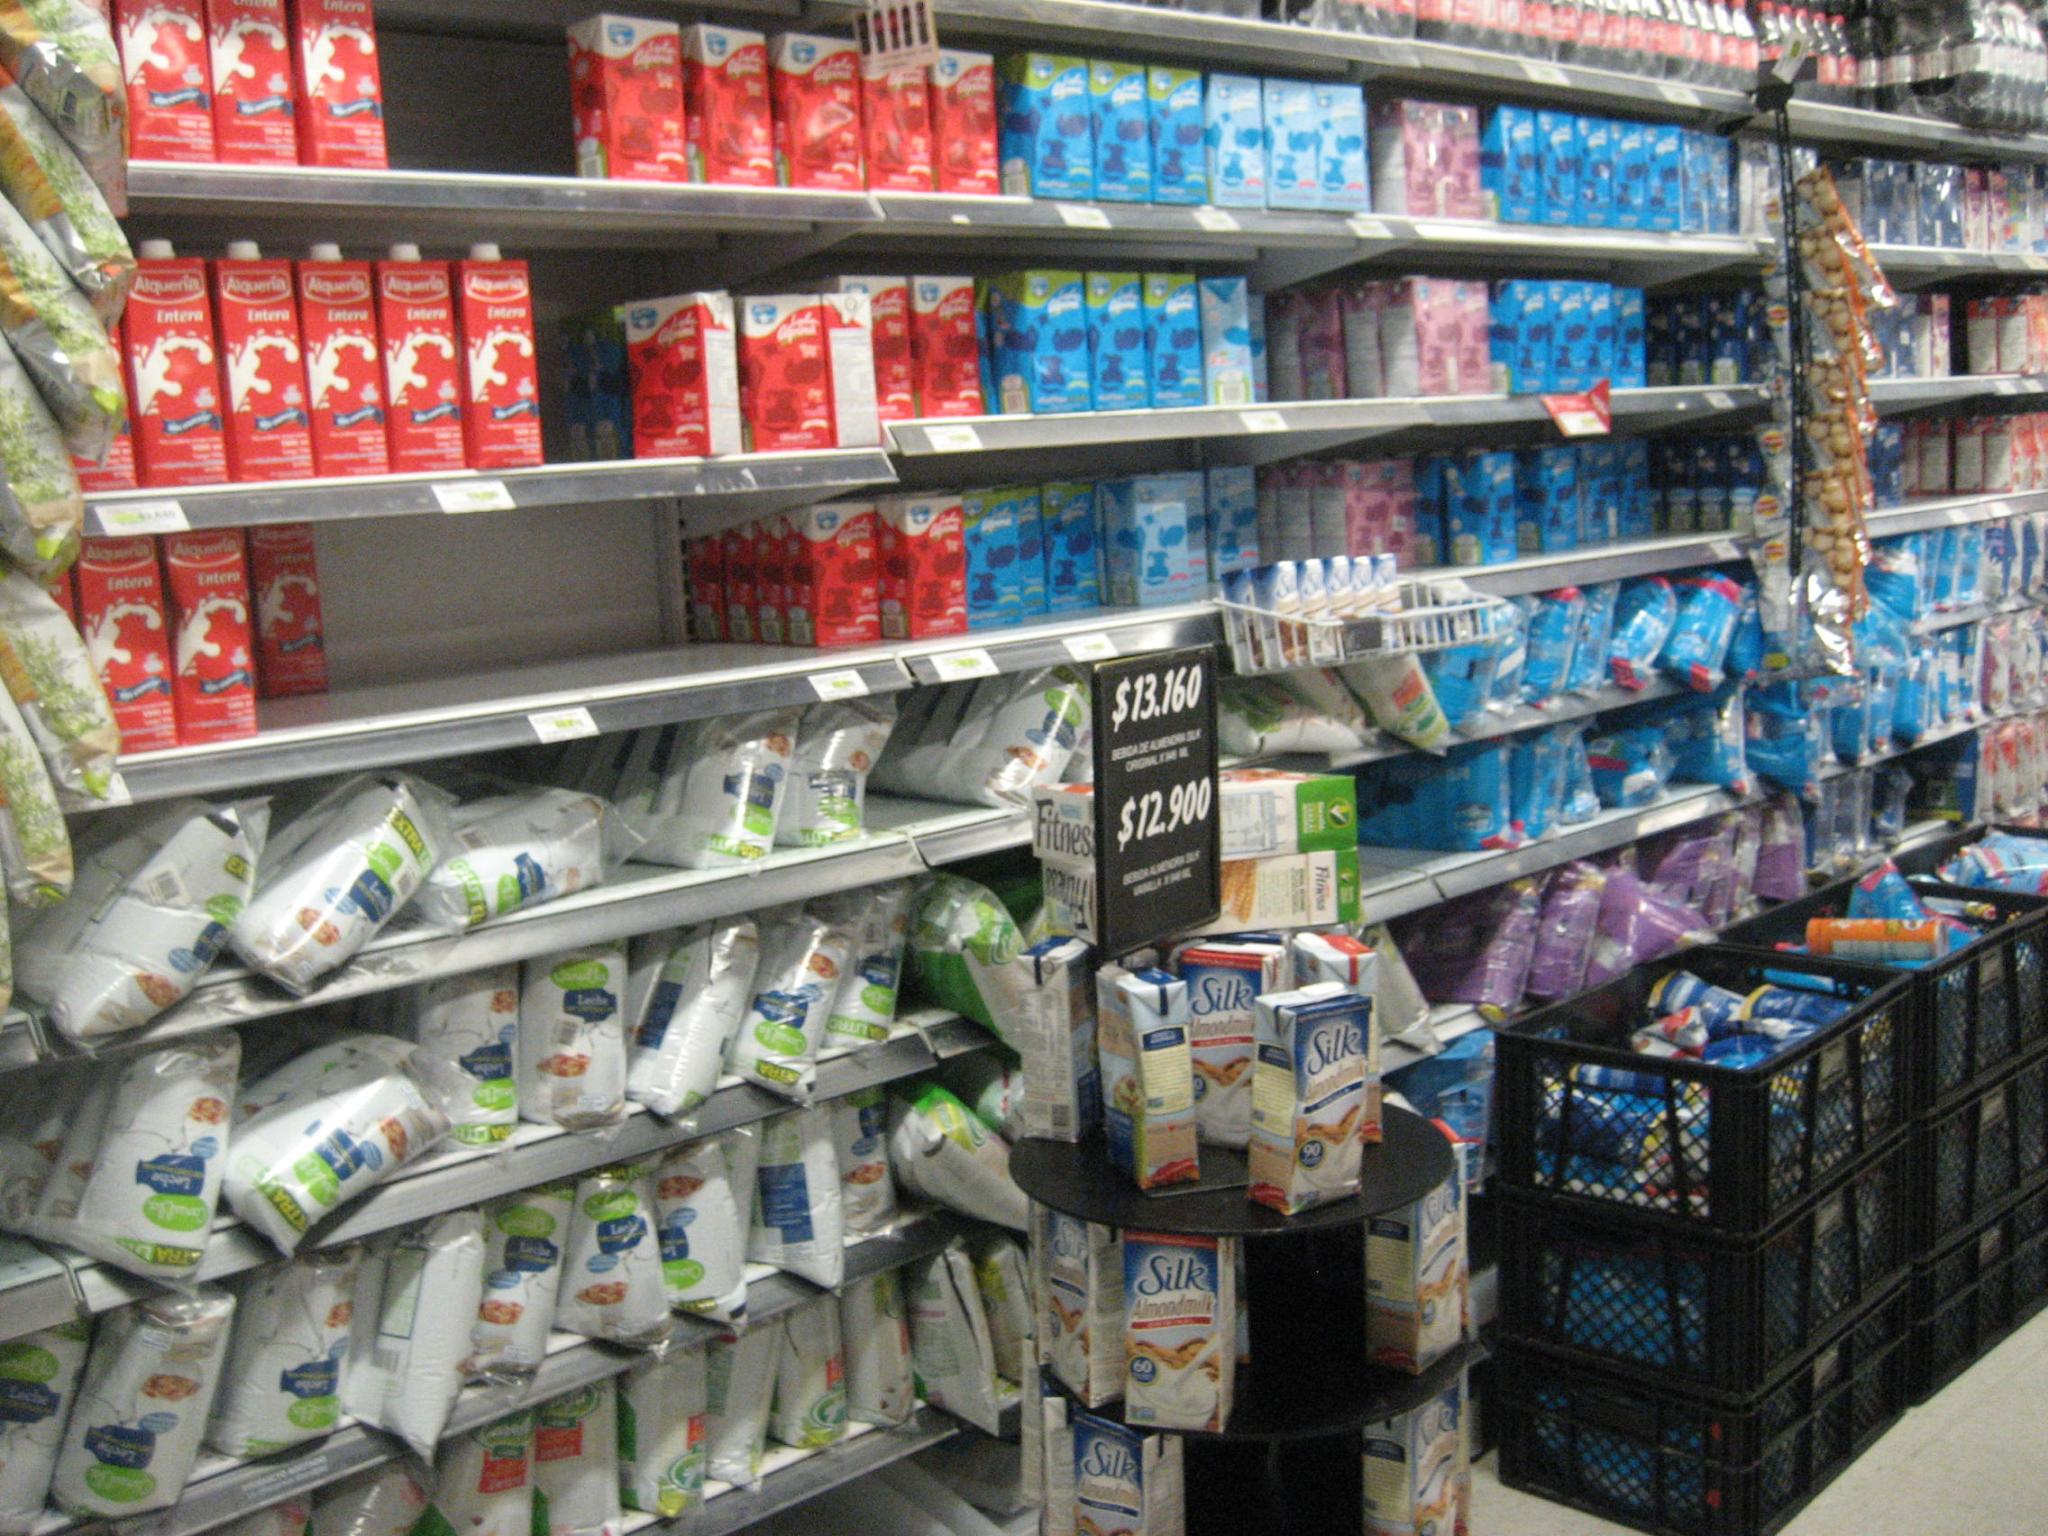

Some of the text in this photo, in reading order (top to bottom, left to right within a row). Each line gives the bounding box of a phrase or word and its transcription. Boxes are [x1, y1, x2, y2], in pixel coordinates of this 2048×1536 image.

[1111, 662, 1203, 733] $13.160
[1035, 798, 1095, 858] Fitnes
[1117, 776, 1212, 853] $12.900
[1313, 865, 1330, 911] Fitness
[1190, 976, 1253, 1016] Silk
[1307, 1024, 1363, 1076] Silk
[1303, 1143, 1321, 1157] 90
[151, 1172, 190, 1190] Leche
[1138, 1254, 1208, 1296] Silk
[1133, 1360, 1153, 1374] 60
[1083, 1441, 1136, 1480] Silk
